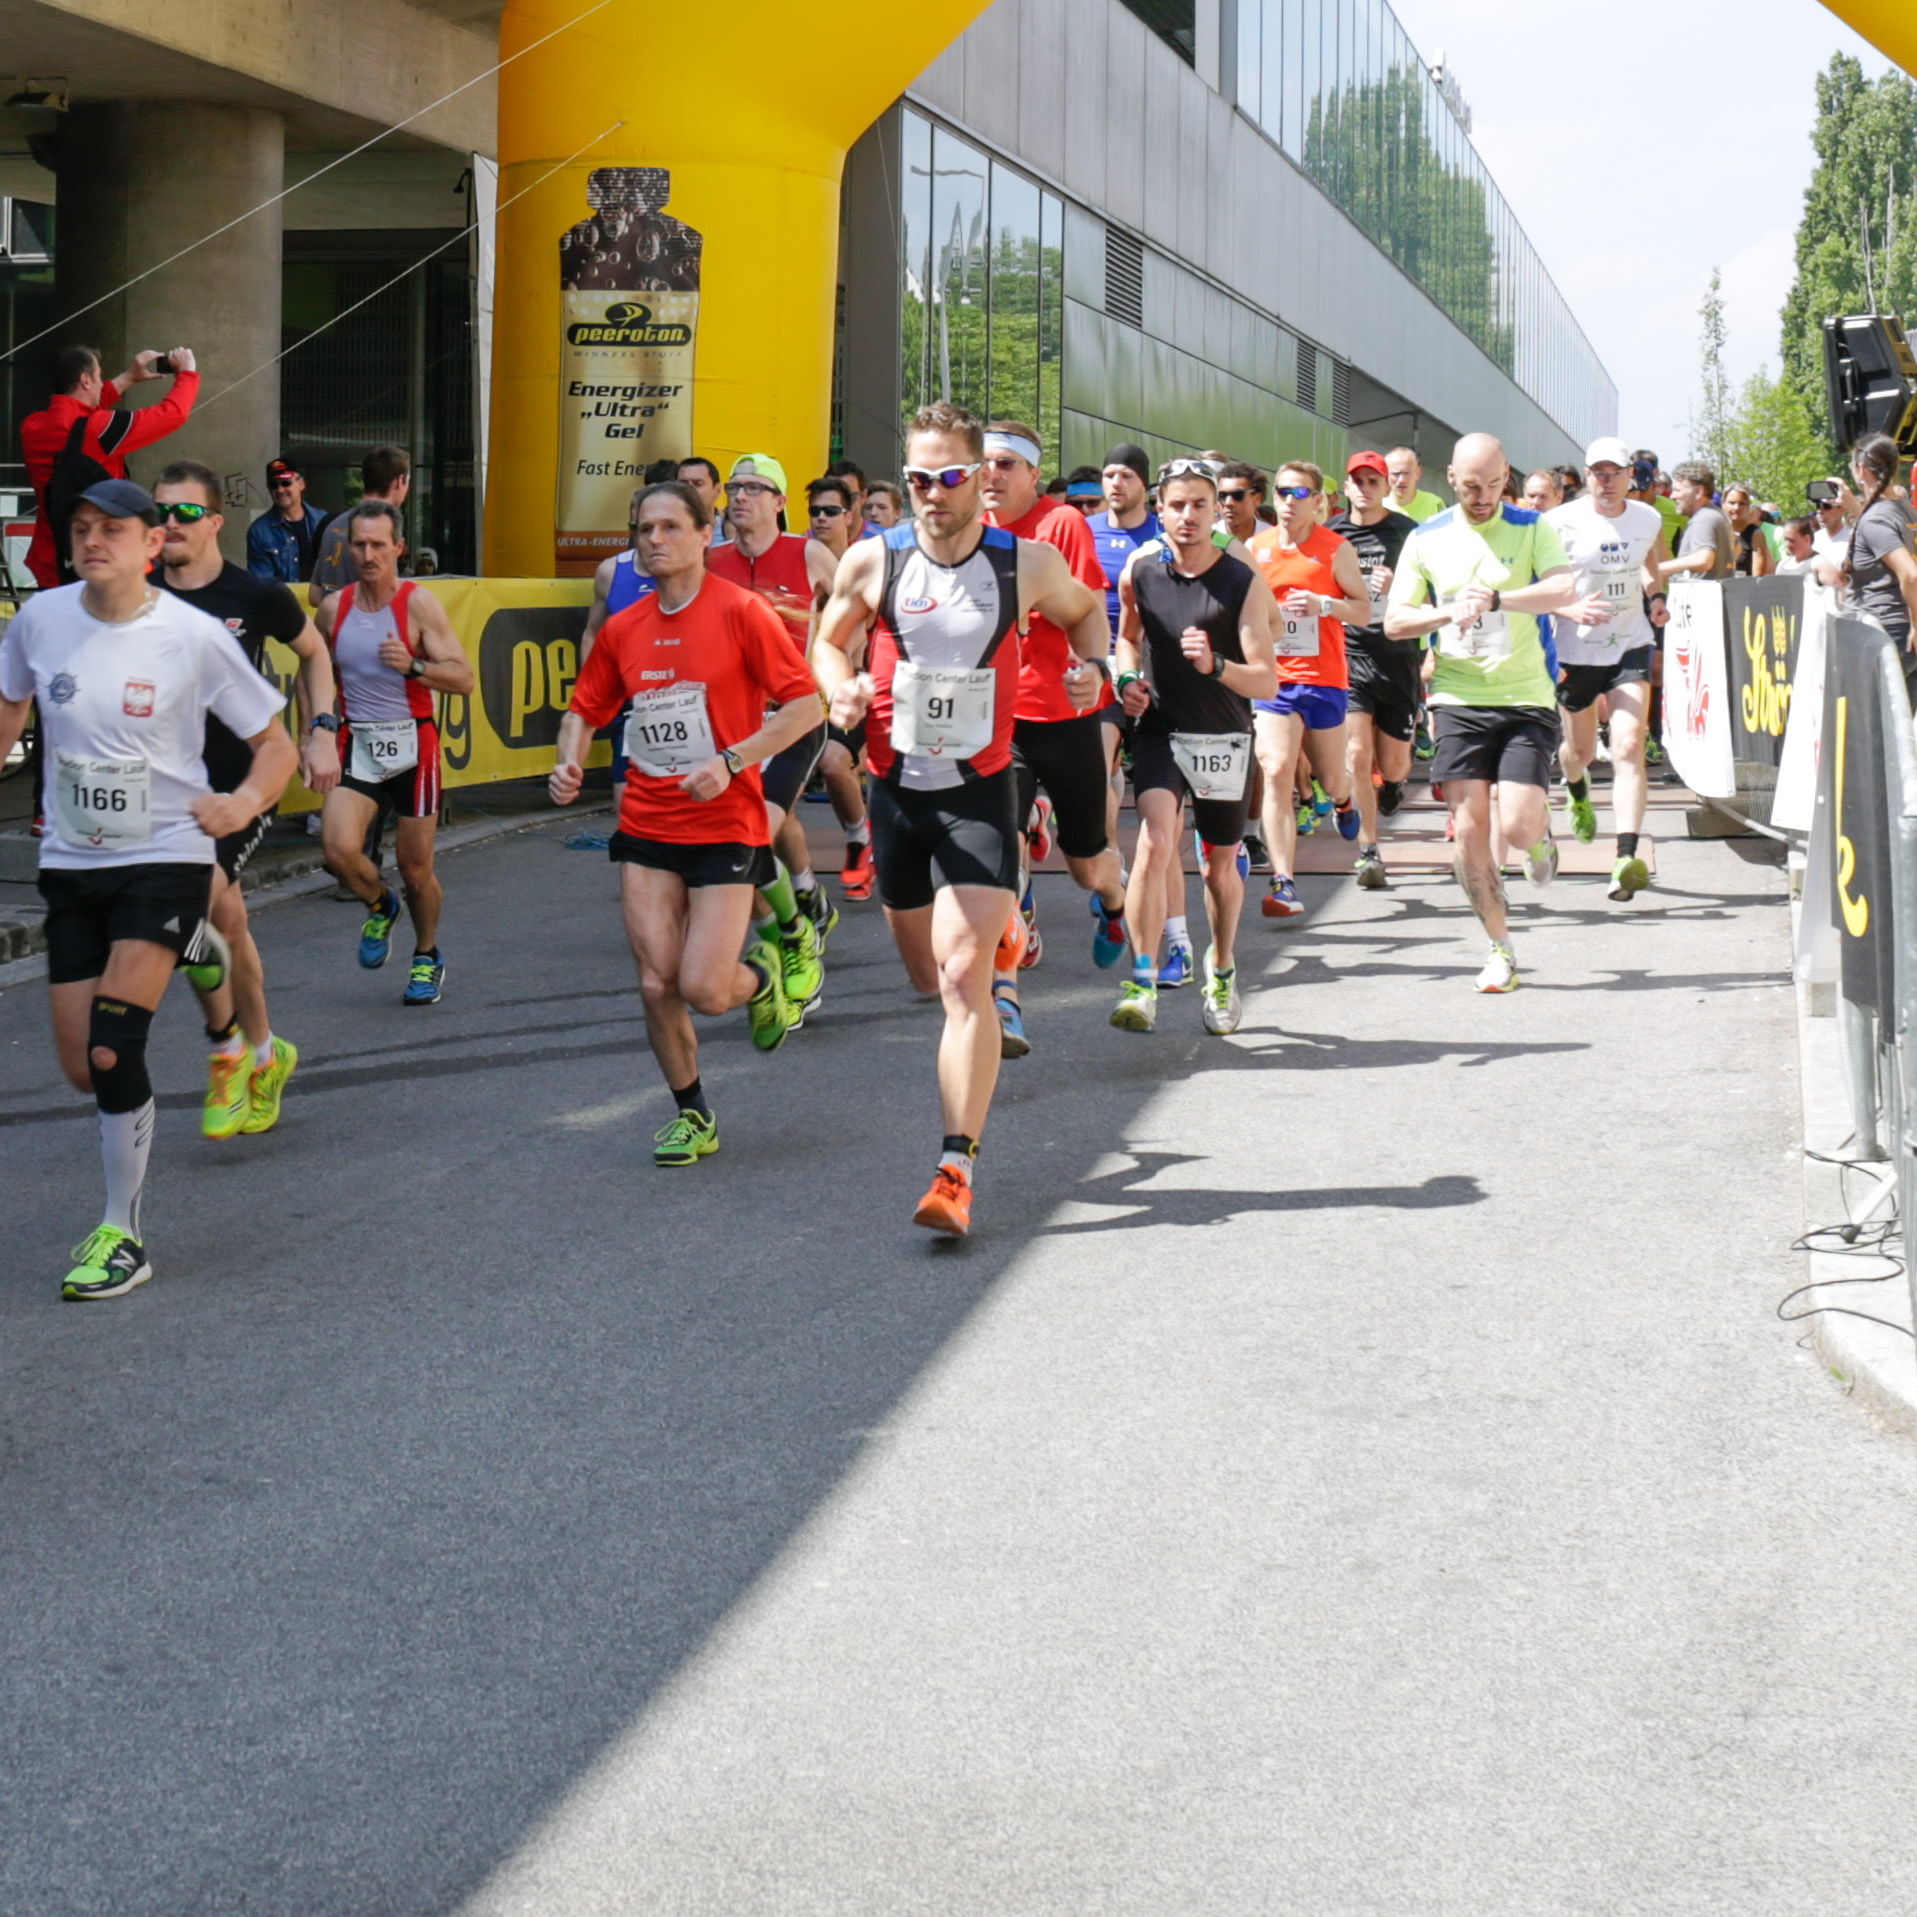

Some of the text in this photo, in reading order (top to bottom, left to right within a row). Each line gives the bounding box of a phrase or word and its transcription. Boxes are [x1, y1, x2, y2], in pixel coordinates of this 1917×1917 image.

[574, 326, 684, 345] peeroton
[568, 381, 683, 401] Energizer
[605, 423, 645, 439] Gel
[577, 460, 647, 476] Fast Ene
[1600, 555, 1631, 565] OMV
[1606, 583, 1625, 597] 111
[650, 701, 676, 712] Center
[678, 695, 699, 707] Lauf
[927, 697, 955, 719] 91
[639, 721, 689, 744] 1128
[367, 741, 398, 758] 126
[1191, 755, 1232, 773] 1163
[72, 784, 127, 812] 1166
